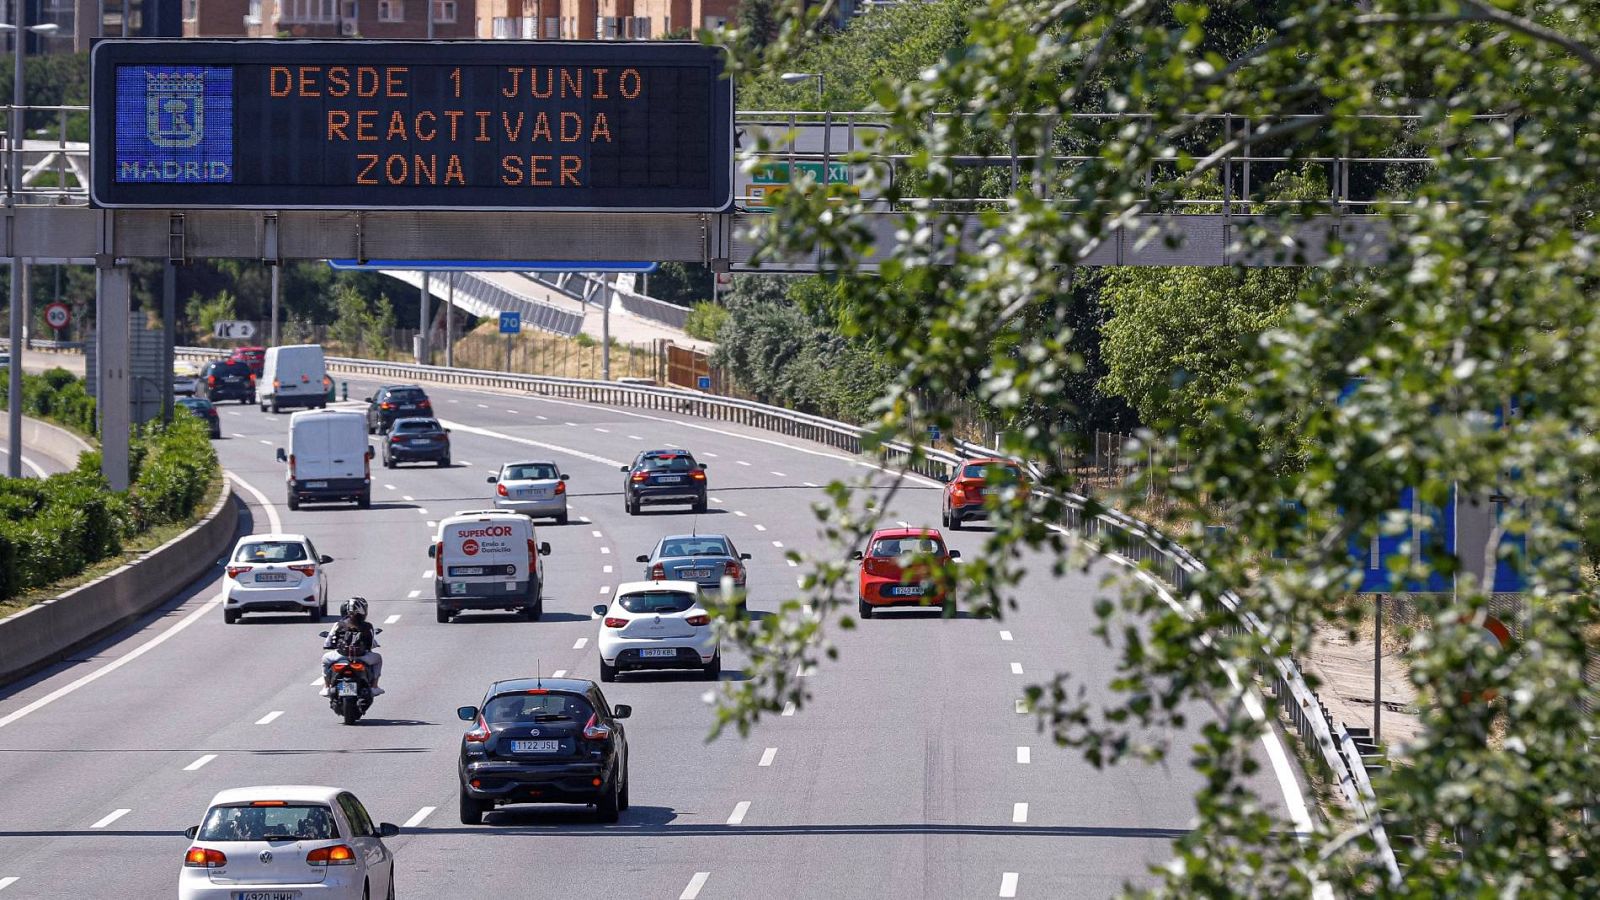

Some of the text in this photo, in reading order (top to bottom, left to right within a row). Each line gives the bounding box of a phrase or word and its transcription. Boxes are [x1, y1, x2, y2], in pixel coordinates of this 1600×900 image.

[271, 67, 641, 98] DESDE 1 JUNIO
[328, 110, 611, 142] REACTIVADA
[121, 161, 230, 179] MADRID
[357, 154, 582, 186] ZONA SER
[502, 317, 518, 328] 70
[241, 325, 248, 336] 2
[458, 526, 512, 537] SUPERCOR
[518, 741, 556, 750] 1122 JSL
